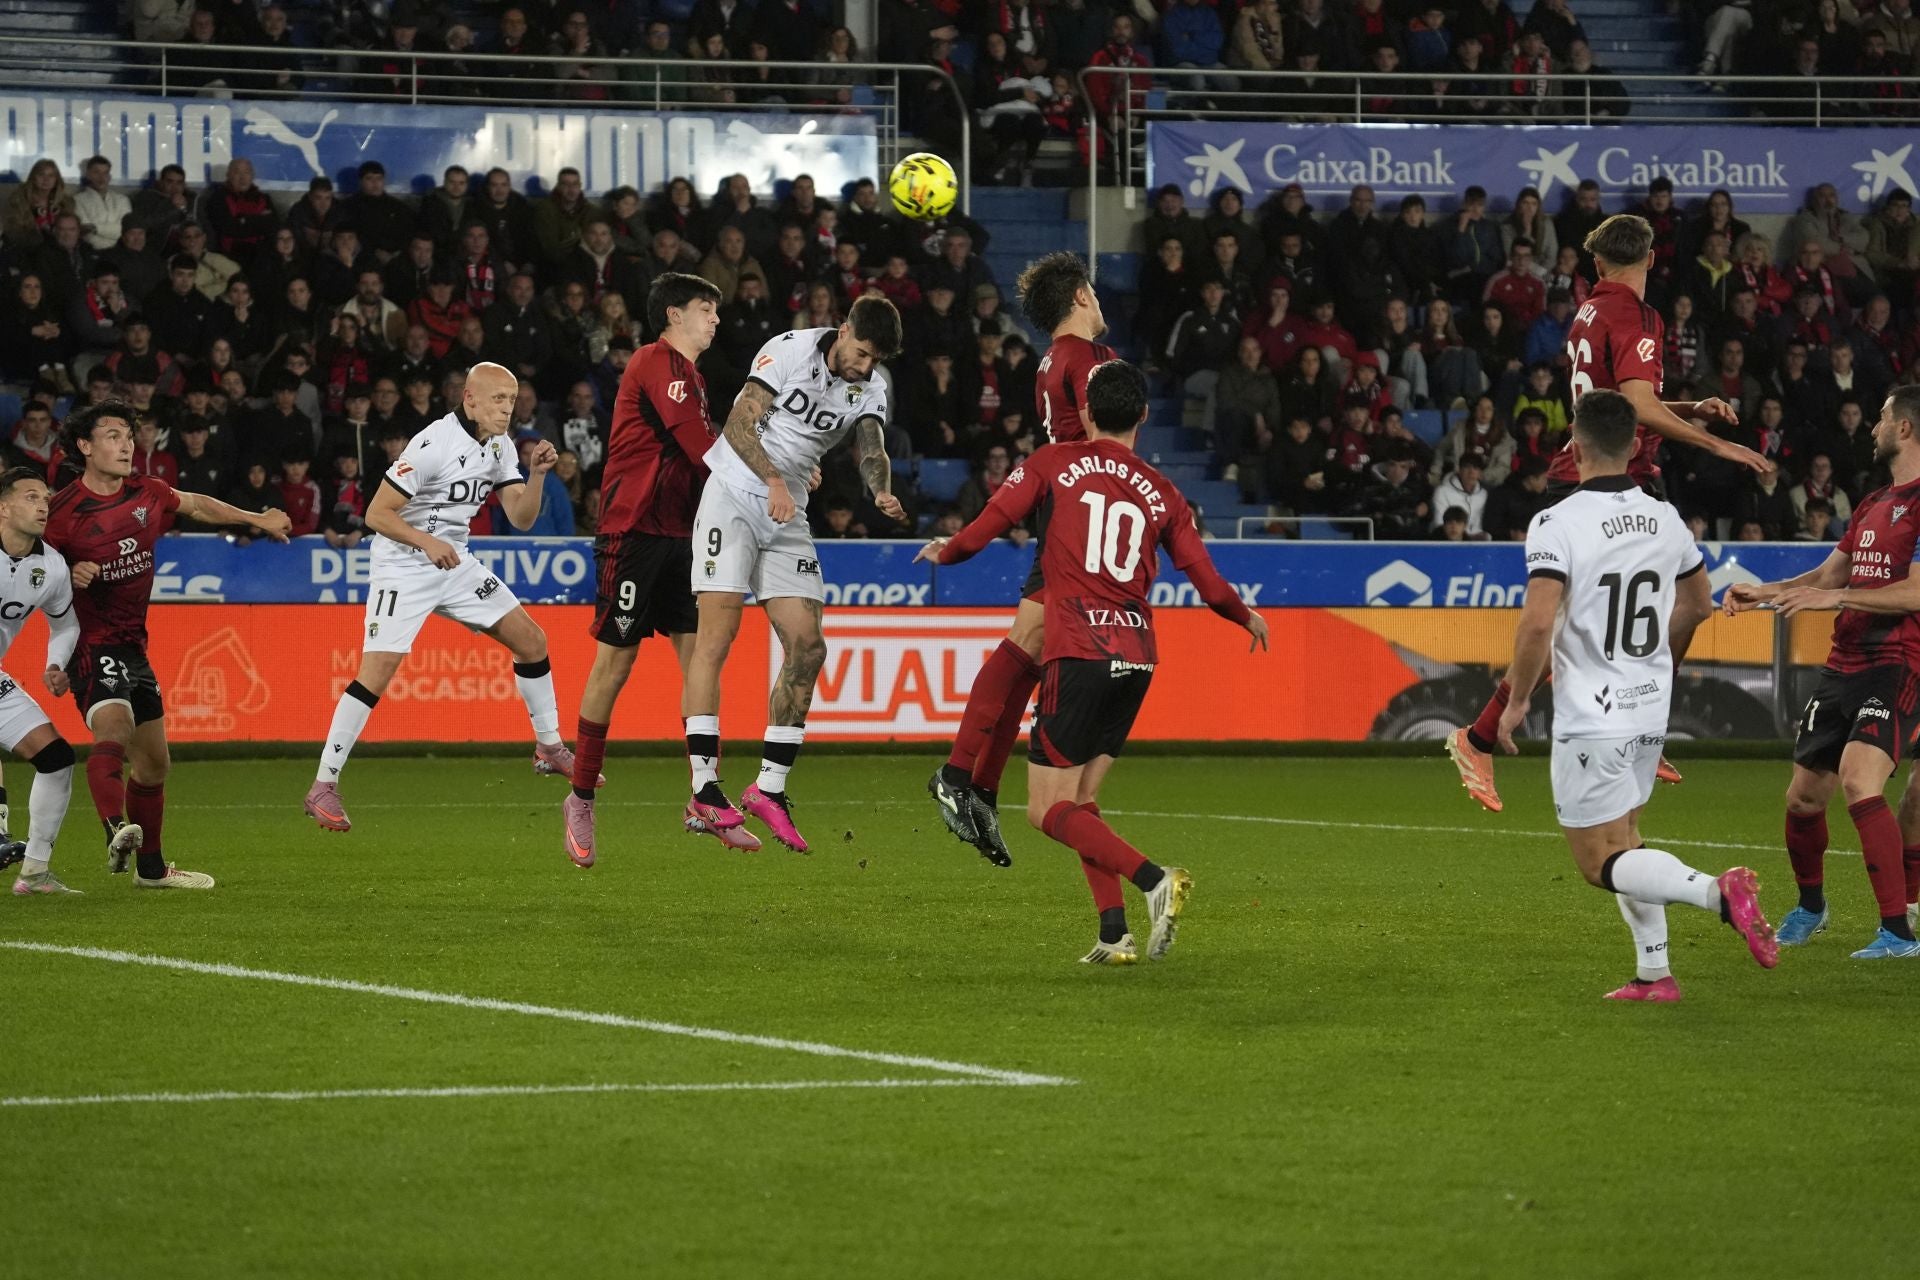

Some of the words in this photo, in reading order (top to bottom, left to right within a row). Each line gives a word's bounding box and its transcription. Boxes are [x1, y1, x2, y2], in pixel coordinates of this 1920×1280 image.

[0, 96, 231, 182] PUMA
[486, 112, 716, 193] PUMA
[1264, 144, 1456, 185] CaixaBank
[1597, 147, 1788, 187] CaixaBank
[782, 386, 846, 431] DIGI
[448, 479, 493, 503] DIG
[1057, 455, 1129, 488] CARLOS
[1129, 471, 1167, 522] FDEZ.
[707, 527, 722, 557] 9
[1079, 490, 1147, 583] 10
[1601, 514, 1658, 539] CURRO
[311, 549, 587, 586] DETIVO
[375, 589, 399, 617] 11
[618, 580, 637, 611] 9
[1598, 569, 1661, 661] 16
